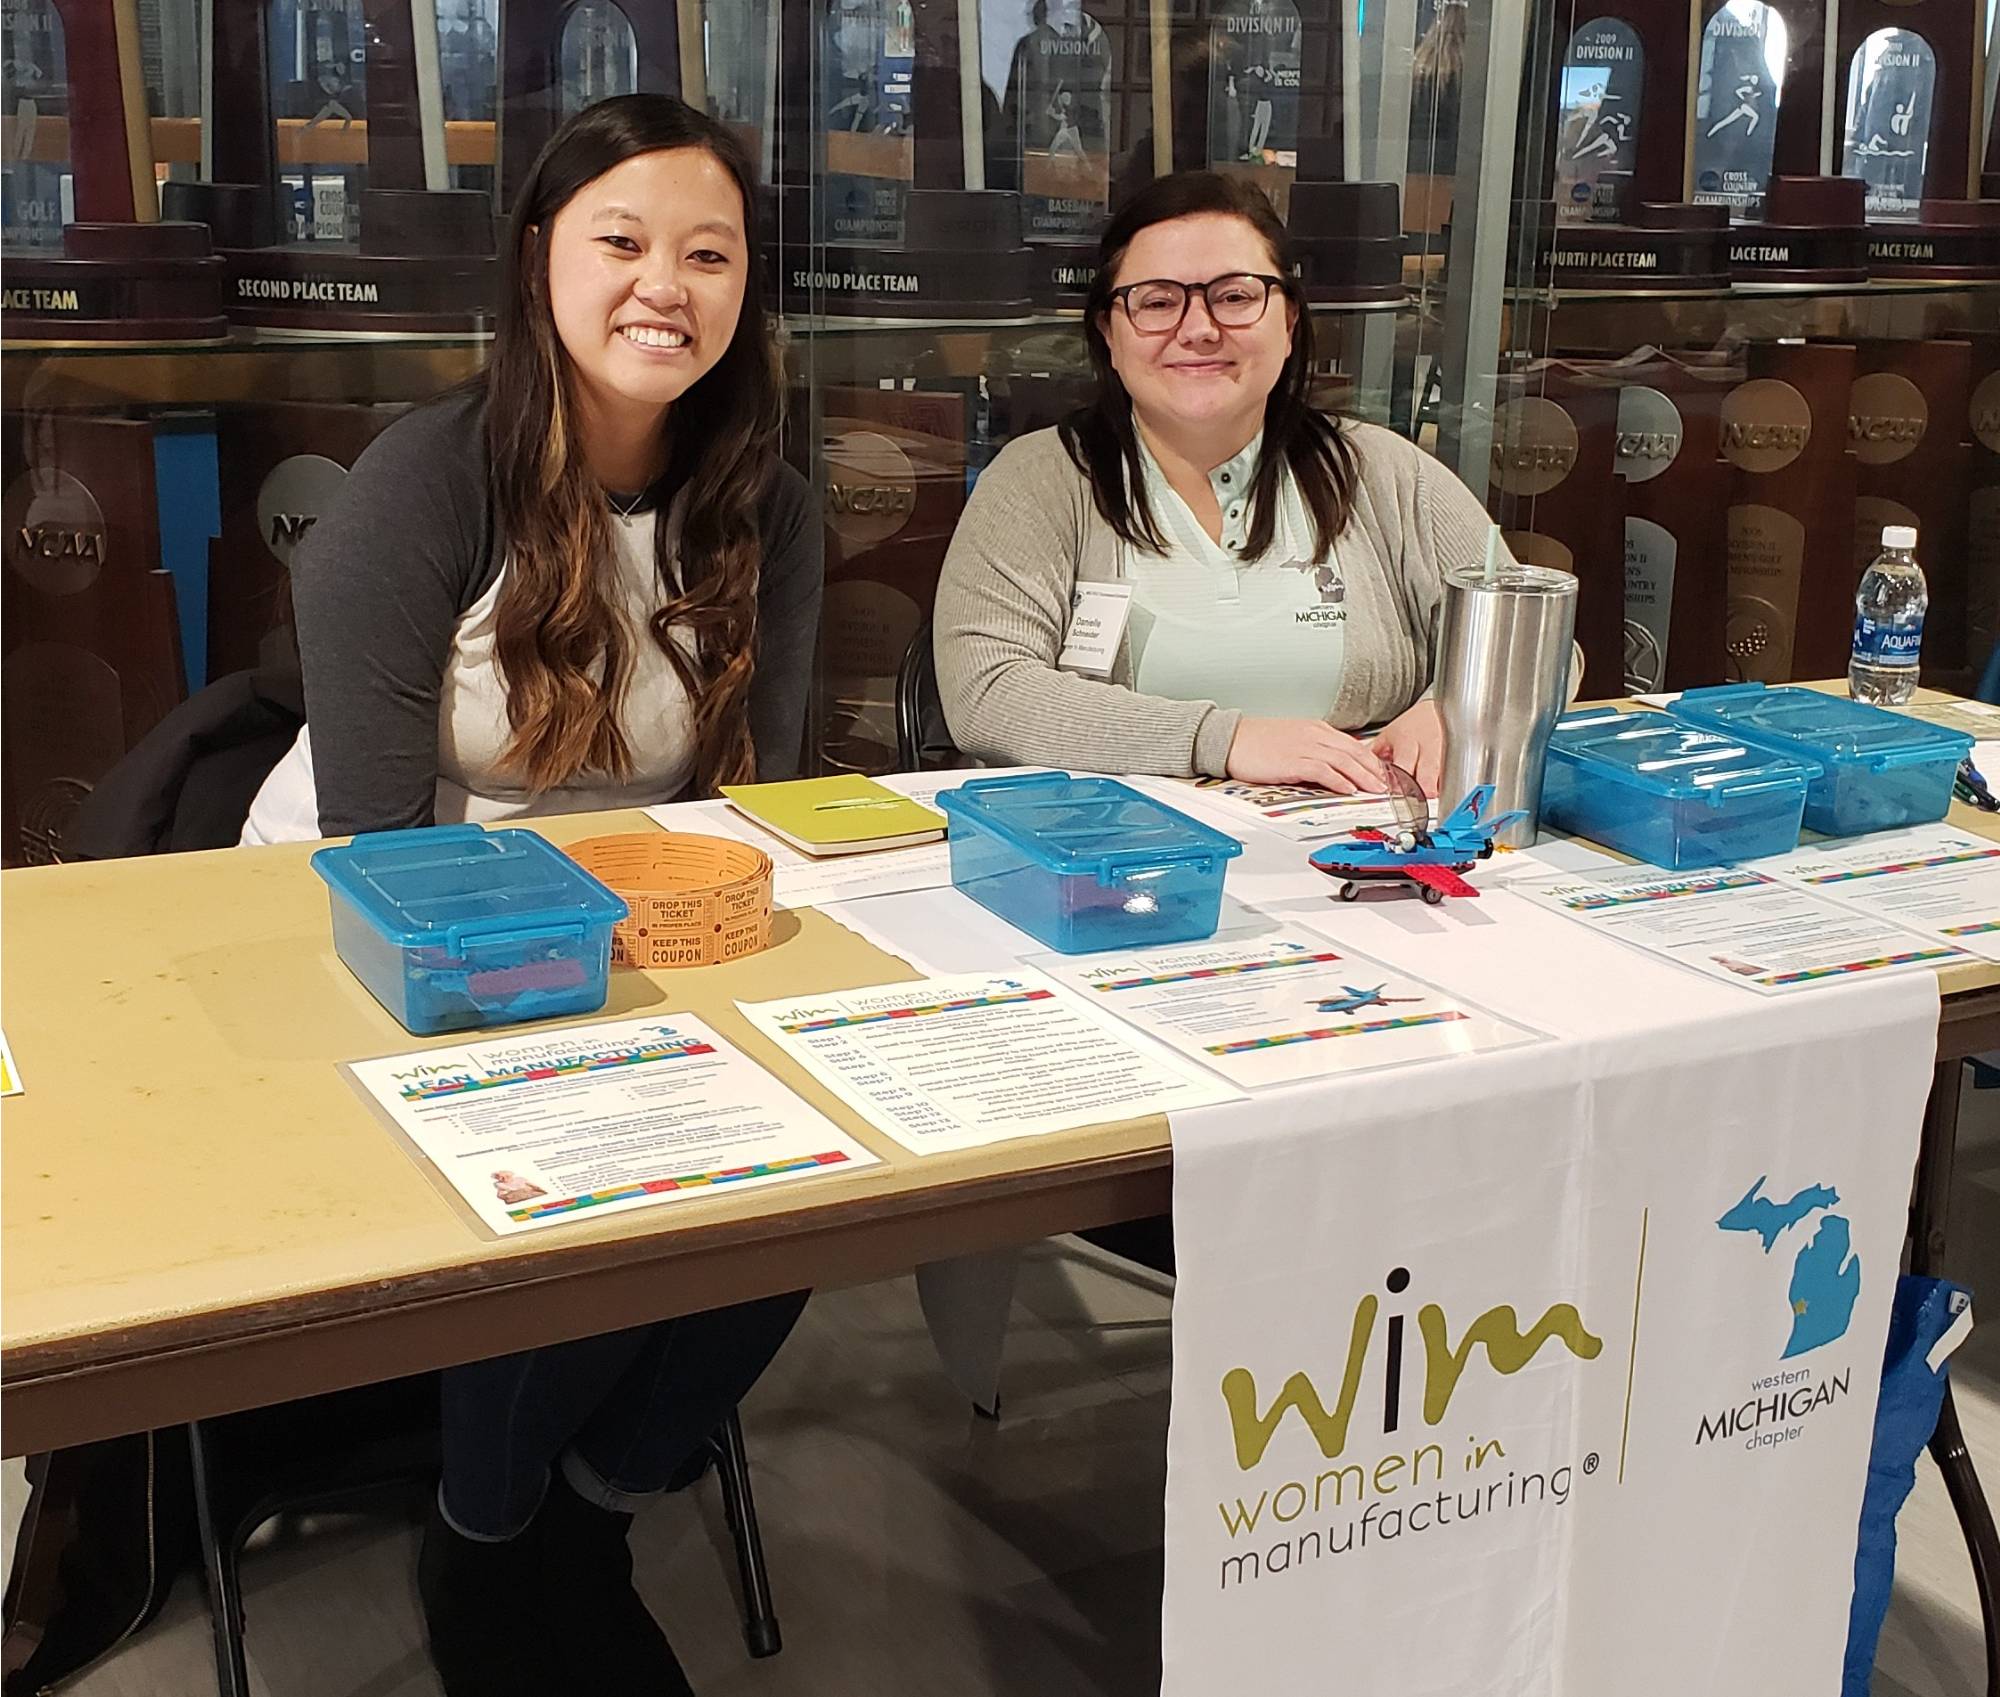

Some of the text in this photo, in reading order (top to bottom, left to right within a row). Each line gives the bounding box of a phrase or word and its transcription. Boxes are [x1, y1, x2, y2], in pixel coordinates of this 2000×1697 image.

[1227, 16, 1294, 33] DIVISION II
[1595, 33, 1617, 44] 2009
[1040, 40, 1101, 55] DIVISION II
[1576, 45, 1634, 60] DIVISION II
[1912, 54, 1920, 67] II
[1723, 172, 1748, 181] CROSS
[1723, 182, 1758, 191] COUNTRY
[1694, 195, 1761, 207] CHAMPIONSHIPS
[17, 200, 56, 221] GOLF
[1730, 246, 1789, 261] LACE TEAM
[1868, 243, 1933, 258] PLACE TEAM
[1543, 251, 1656, 268] FOURTH PLACE TEAM
[793, 271, 919, 292] SECOND PLACE TEAM
[1051, 267, 1097, 284] CHAMP
[238, 279, 378, 302] SECOND PLACE TEAM
[1, 289, 79, 310] ACE TEAM
[1720, 422, 1807, 450] NCAA
[725, 886, 760, 904] DROP THIS
[652, 900, 702, 910] DROP THIS
[731, 899, 755, 911] TICKET
[660, 909, 695, 919] TICKET
[725, 923, 758, 941] KEEP THIS
[652, 937, 701, 947] KEEP THIS
[724, 935, 759, 957] COUPON
[652, 948, 701, 964] COUPON
[850, 990, 931, 1006] women
[772, 1007, 839, 1022] wim
[483, 1040, 577, 1060] women
[391, 1063, 468, 1081] wim
[402, 1073, 475, 1093] LEAN
[486, 1038, 702, 1078] MANUFACTURING
[1222, 1267, 1603, 1470] wim
[1752, 1368, 1810, 1392] western
[1695, 1367, 1851, 1445] MICHIGAN
[1745, 1424, 1805, 1451] chapter
[1219, 1436, 1506, 1539] women in
